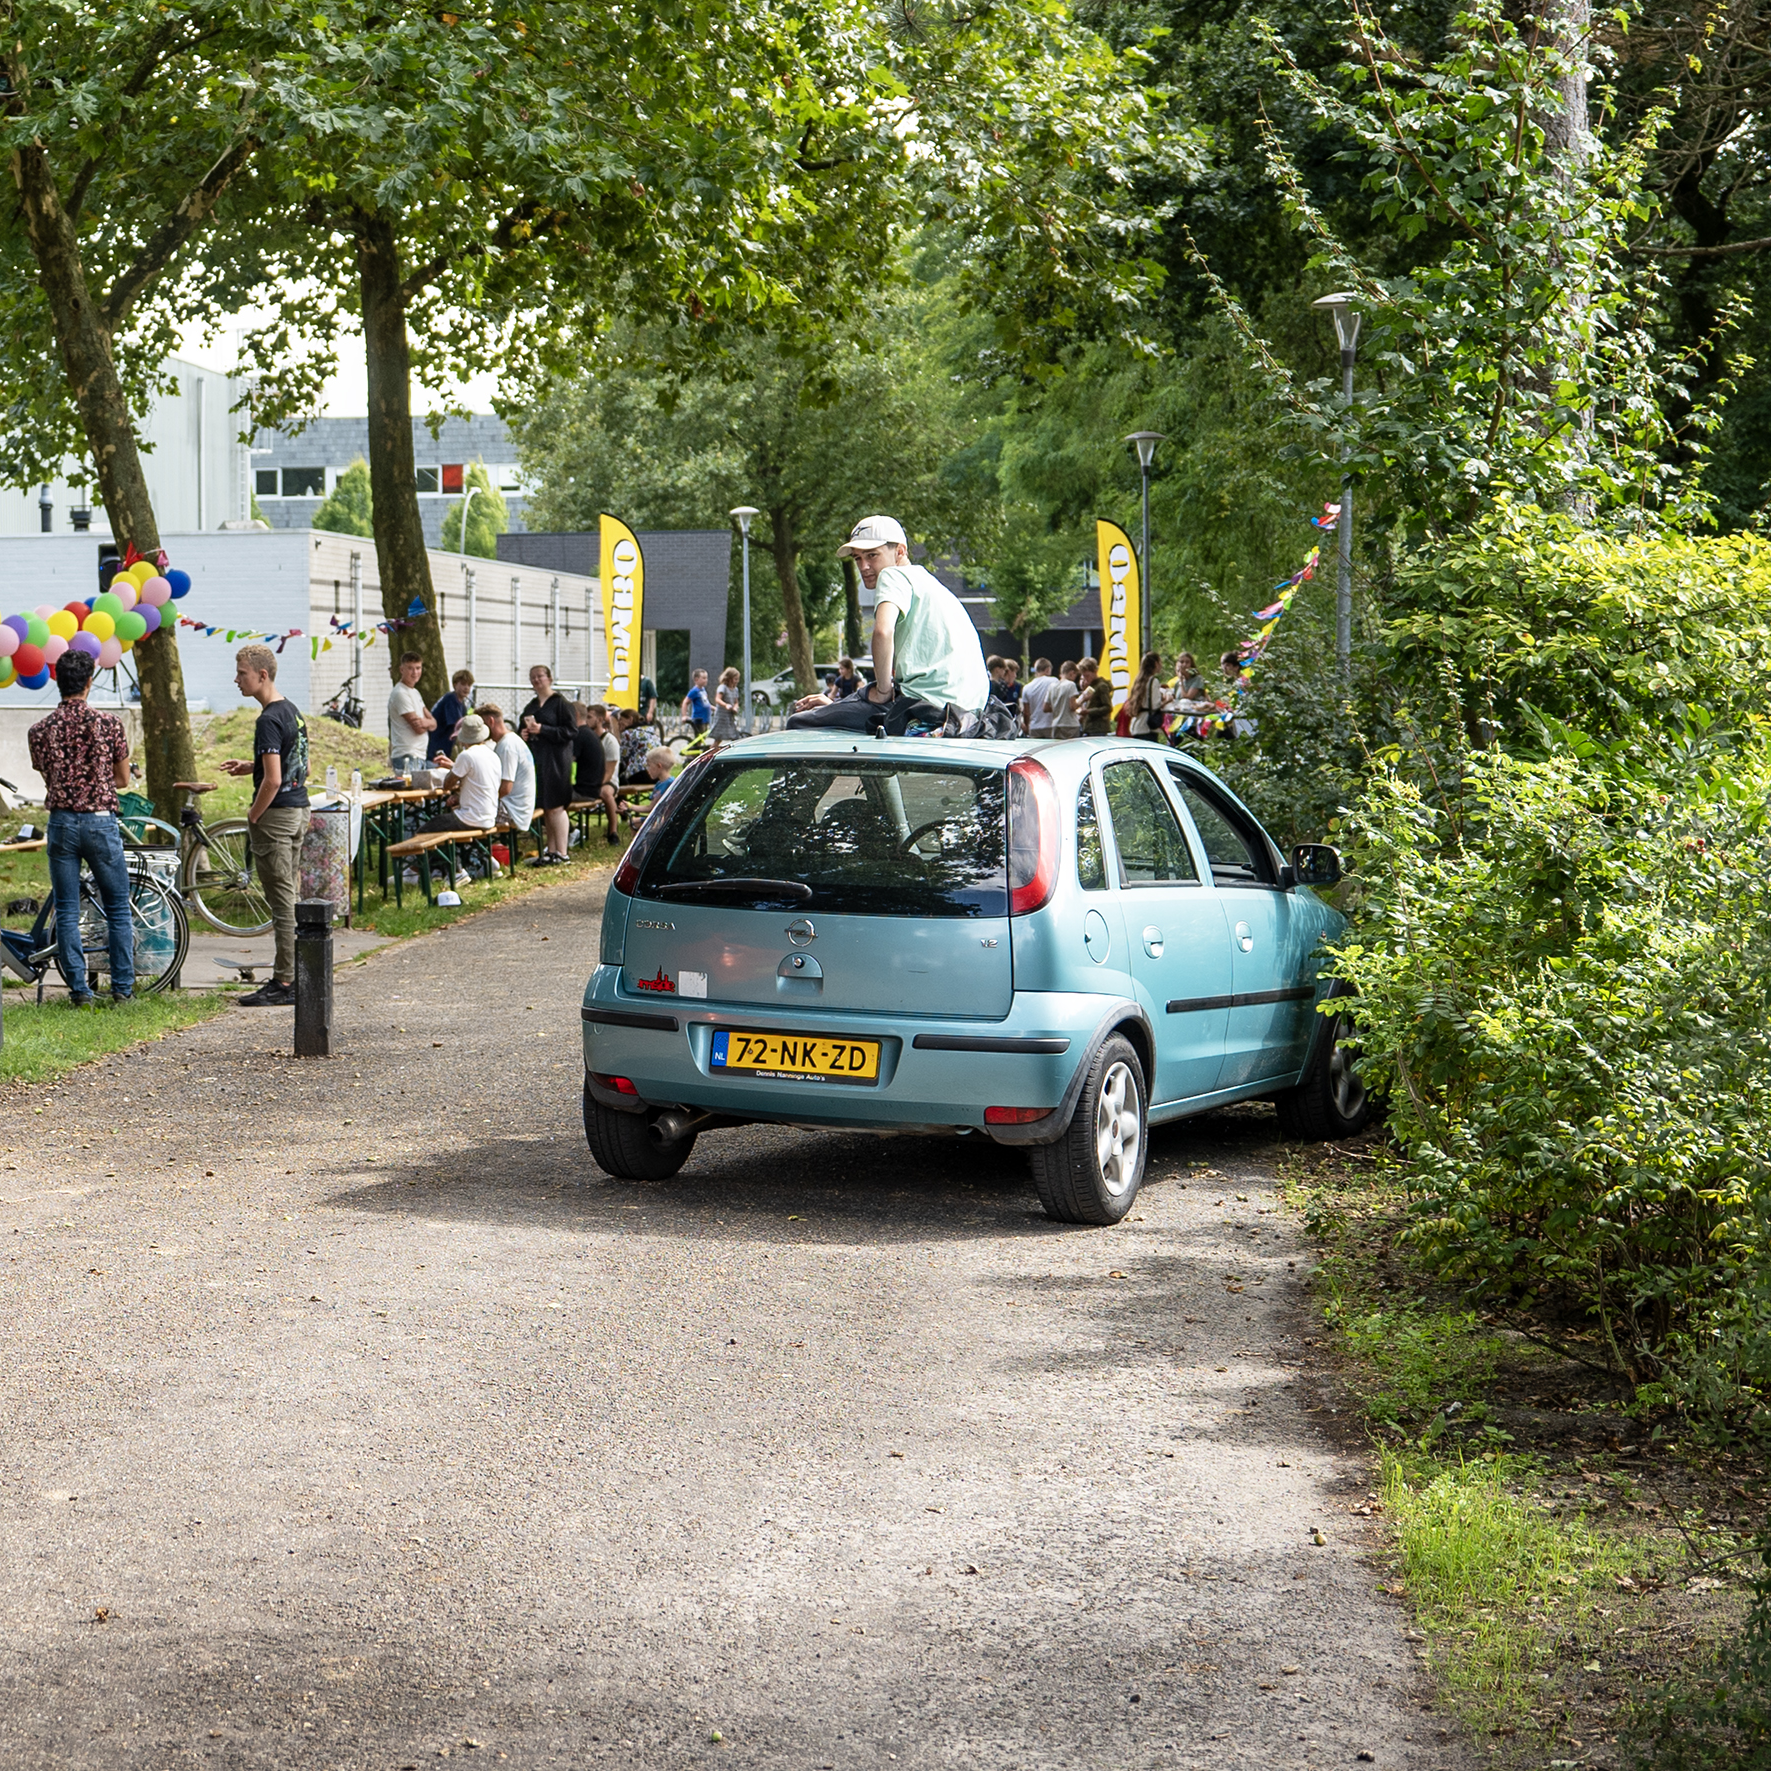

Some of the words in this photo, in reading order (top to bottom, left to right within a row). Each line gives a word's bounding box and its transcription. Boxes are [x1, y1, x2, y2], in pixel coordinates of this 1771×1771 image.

[636, 919, 676, 931] CORSA
[714, 1052, 726, 1061] NL
[736, 1037, 867, 1071] 72-NK-ZD
